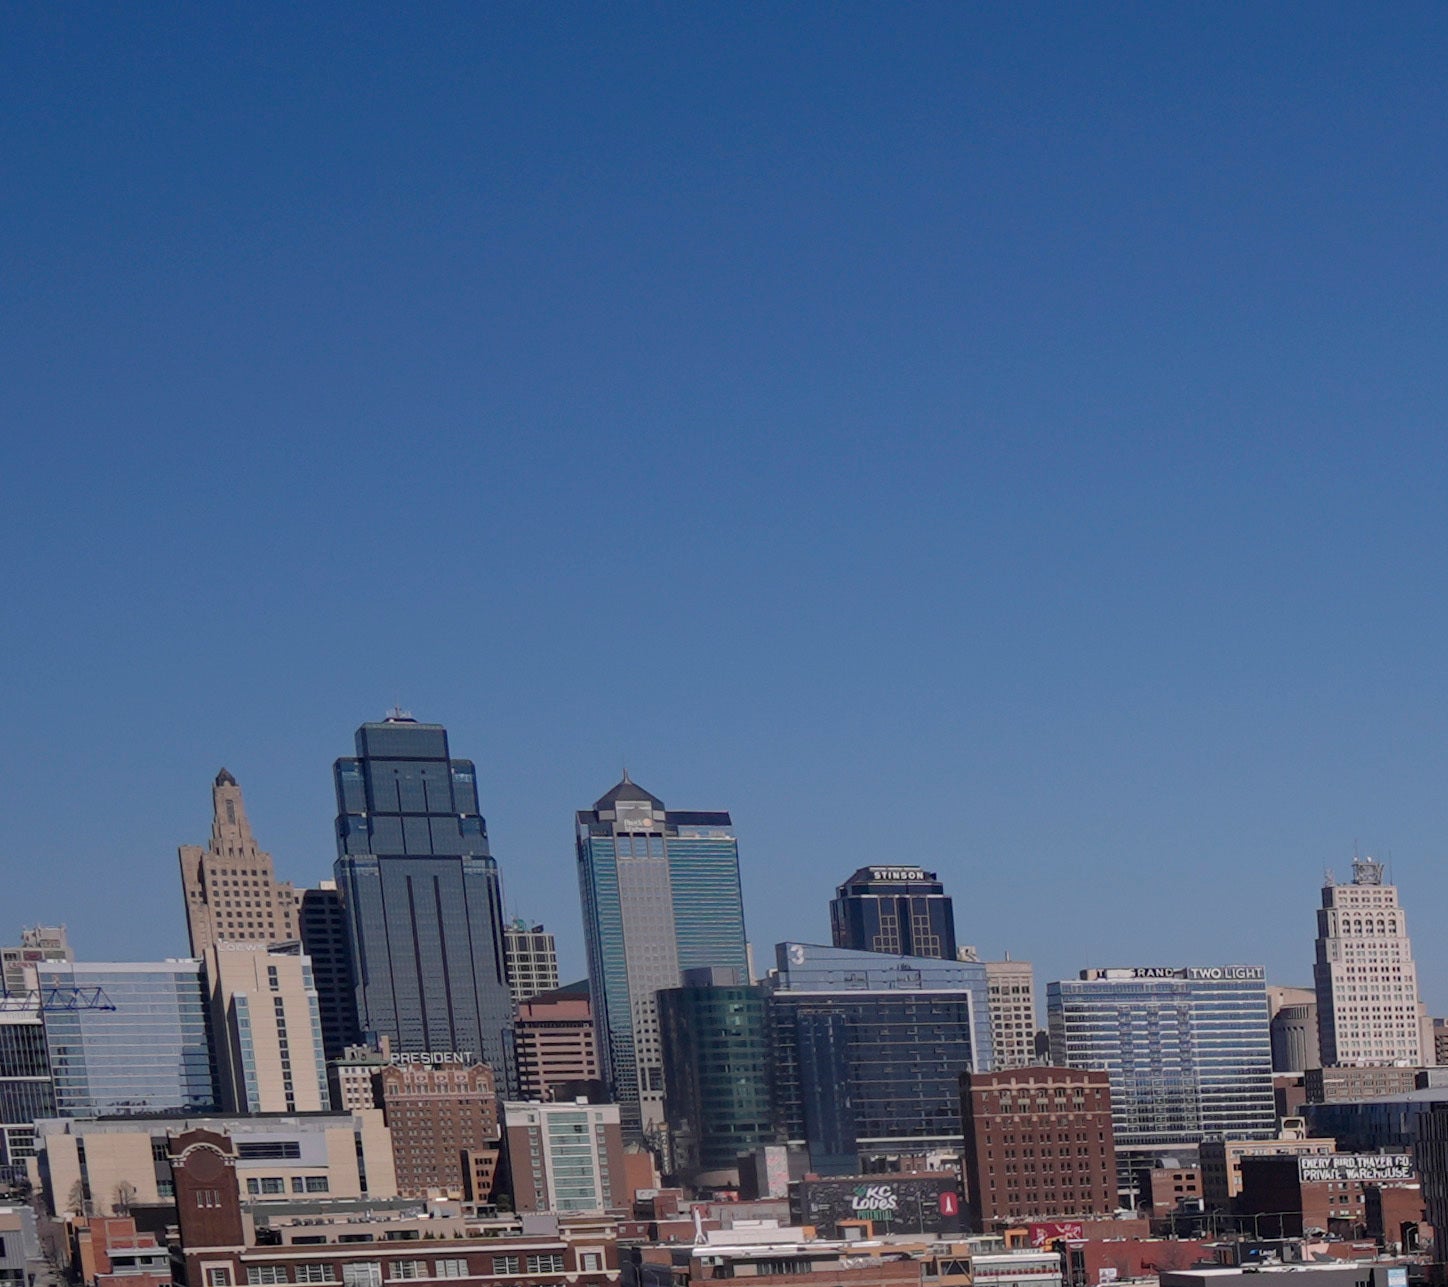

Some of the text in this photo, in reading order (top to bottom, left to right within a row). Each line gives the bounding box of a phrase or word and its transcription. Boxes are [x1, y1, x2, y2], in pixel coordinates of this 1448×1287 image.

[873, 871, 924, 880] STINSON
[790, 944, 805, 966] 3
[1191, 967, 1263, 979] TWO LIGHT
[390, 1051, 473, 1064] PRESIDENT
[866, 1185, 892, 1200] KC
